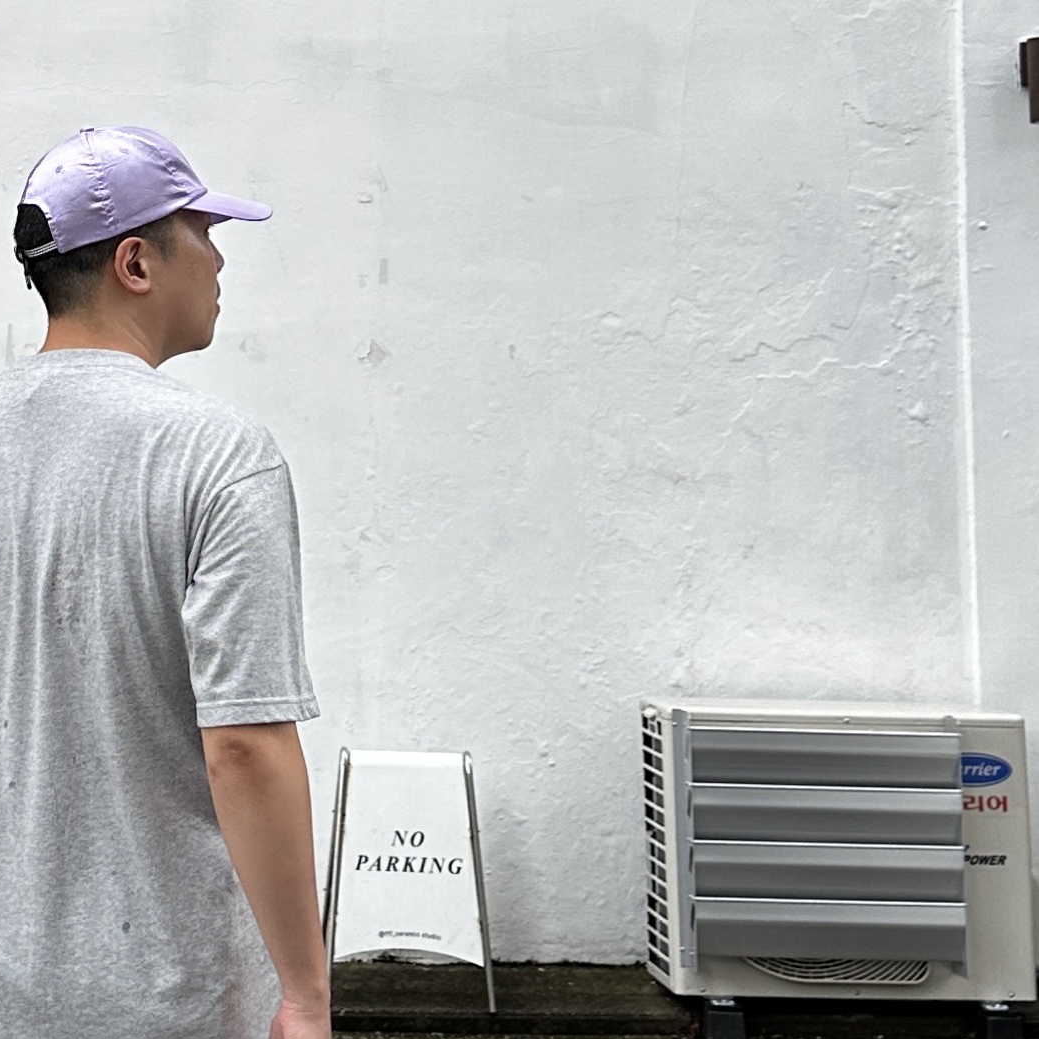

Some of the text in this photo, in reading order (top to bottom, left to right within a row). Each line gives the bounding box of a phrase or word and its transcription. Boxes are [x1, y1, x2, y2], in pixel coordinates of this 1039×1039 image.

[961, 761, 1002, 777] rrier
[963, 795, 1009, 813] 리어
[392, 830, 425, 848] NO
[355, 854, 464, 875] PARKING
